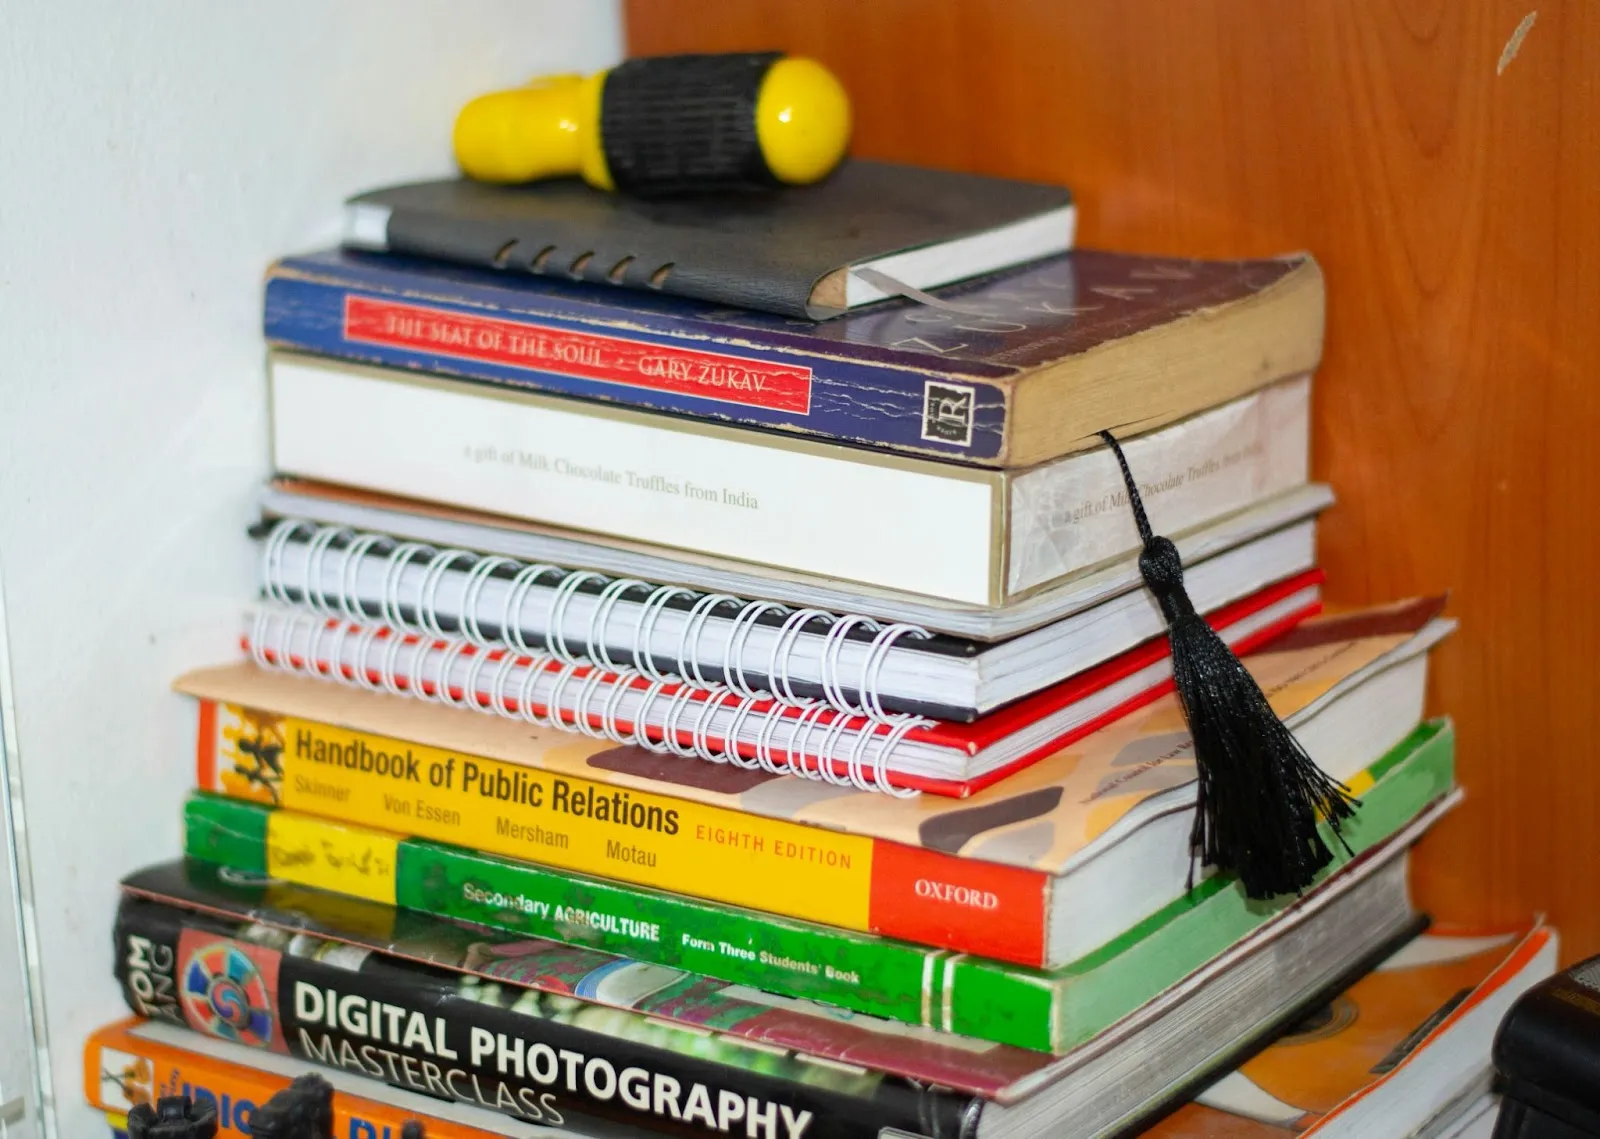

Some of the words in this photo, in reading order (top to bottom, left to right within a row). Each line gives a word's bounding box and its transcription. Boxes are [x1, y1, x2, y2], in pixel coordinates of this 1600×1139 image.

[386, 315, 422, 338] THE
[431, 322, 471, 346] SEAT
[477, 330, 501, 350] OF
[510, 335, 548, 359] THE
[553, 342, 604, 366] SOUL
[639, 357, 692, 381] GARY
[698, 365, 766, 392] ZUKAV
[475, 445, 498, 464] gift
[501, 450, 515, 464] of
[518, 451, 551, 471] Milk
[553, 458, 622, 485] Chocolate
[625, 470, 680, 495] Truffles
[684, 481, 718, 502] from
[722, 488, 759, 510] India
[1073, 500, 1093, 524] gift
[1094, 493, 1109, 513] of
[1109, 489, 1131, 509] Mil
[1186, 457, 1220, 482] Truffles
[297, 730, 420, 783] Handbook
[428, 757, 455, 789] of
[463, 762, 543, 808] Public
[553, 780, 679, 835] Relations
[295, 776, 350, 803] Skinner
[384, 793, 412, 814] Von
[416, 799, 460, 827] Essen
[496, 817, 569, 848] Mersham
[606, 839, 656, 868] Motau
[696, 825, 764, 852] EIGHTH
[775, 841, 851, 869] EDITION
[463, 882, 549, 919] Secondary
[555, 903, 660, 942] AGRICULTURE
[915, 878, 998, 908] OXFORD
[127, 934, 160, 1014] TOM
[682, 932, 714, 953] Form
[719, 942, 755, 962] Three
[760, 950, 821, 976] Students'
[826, 964, 860, 984] Book
[295, 981, 457, 1061] DIGITAL
[470, 1026, 814, 1139] PHOTOGRAPHY
[299, 1027, 565, 1127] MASTERCLASS
